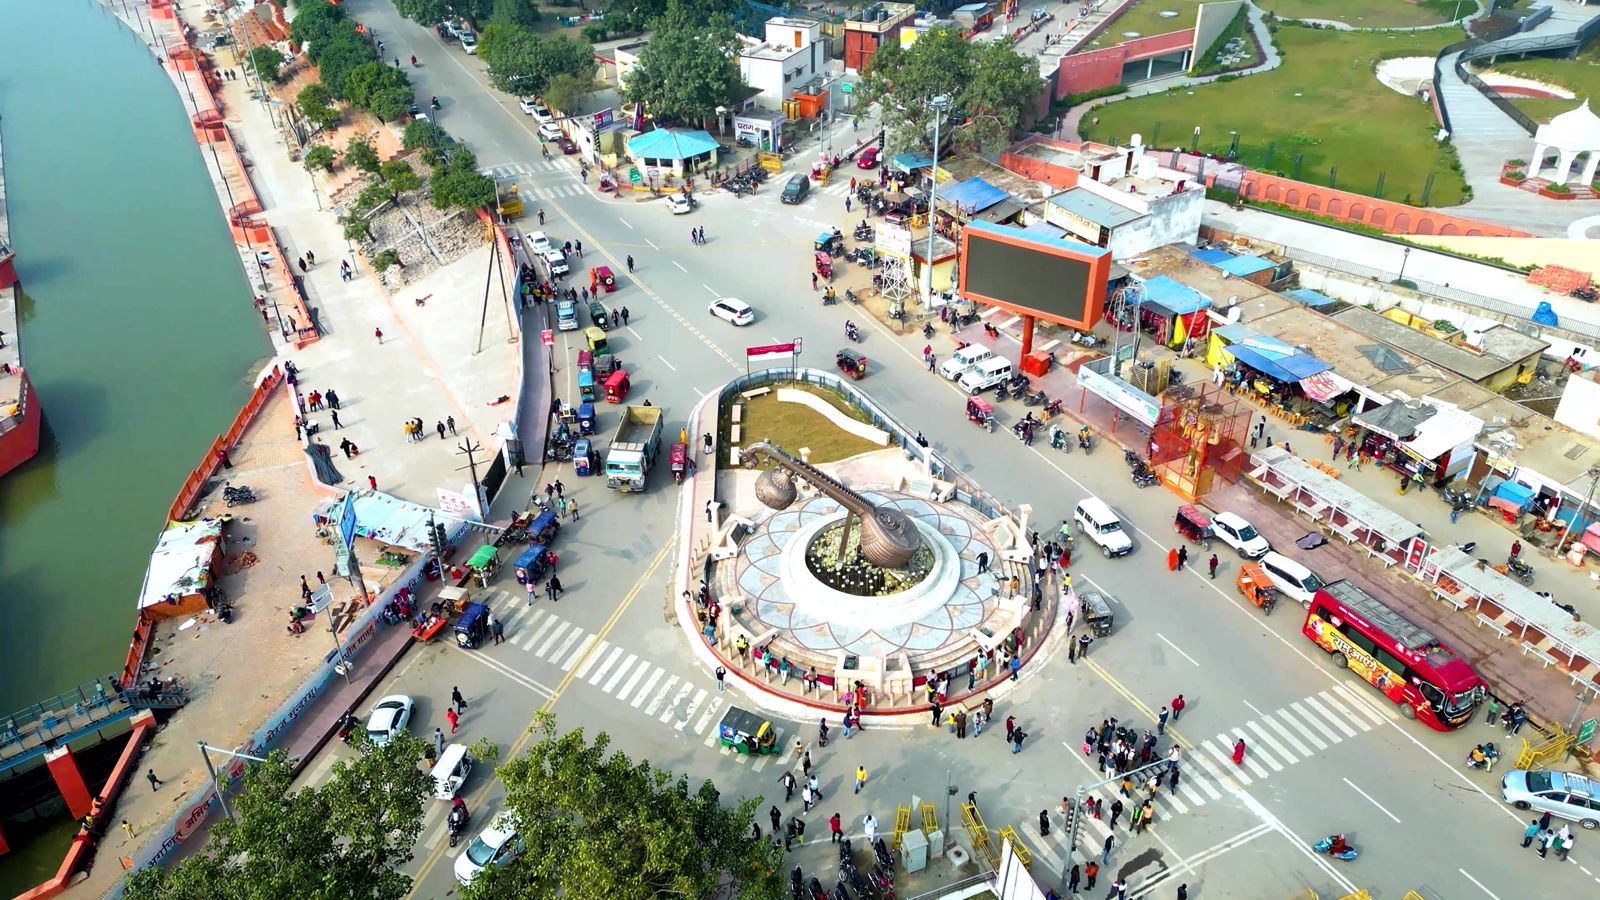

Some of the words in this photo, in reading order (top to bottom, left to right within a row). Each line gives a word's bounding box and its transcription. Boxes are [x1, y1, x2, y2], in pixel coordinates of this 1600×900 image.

[737, 122, 754, 131] पराग
[147, 829, 182, 869] अगणित
[185, 800, 210, 828] अमित
